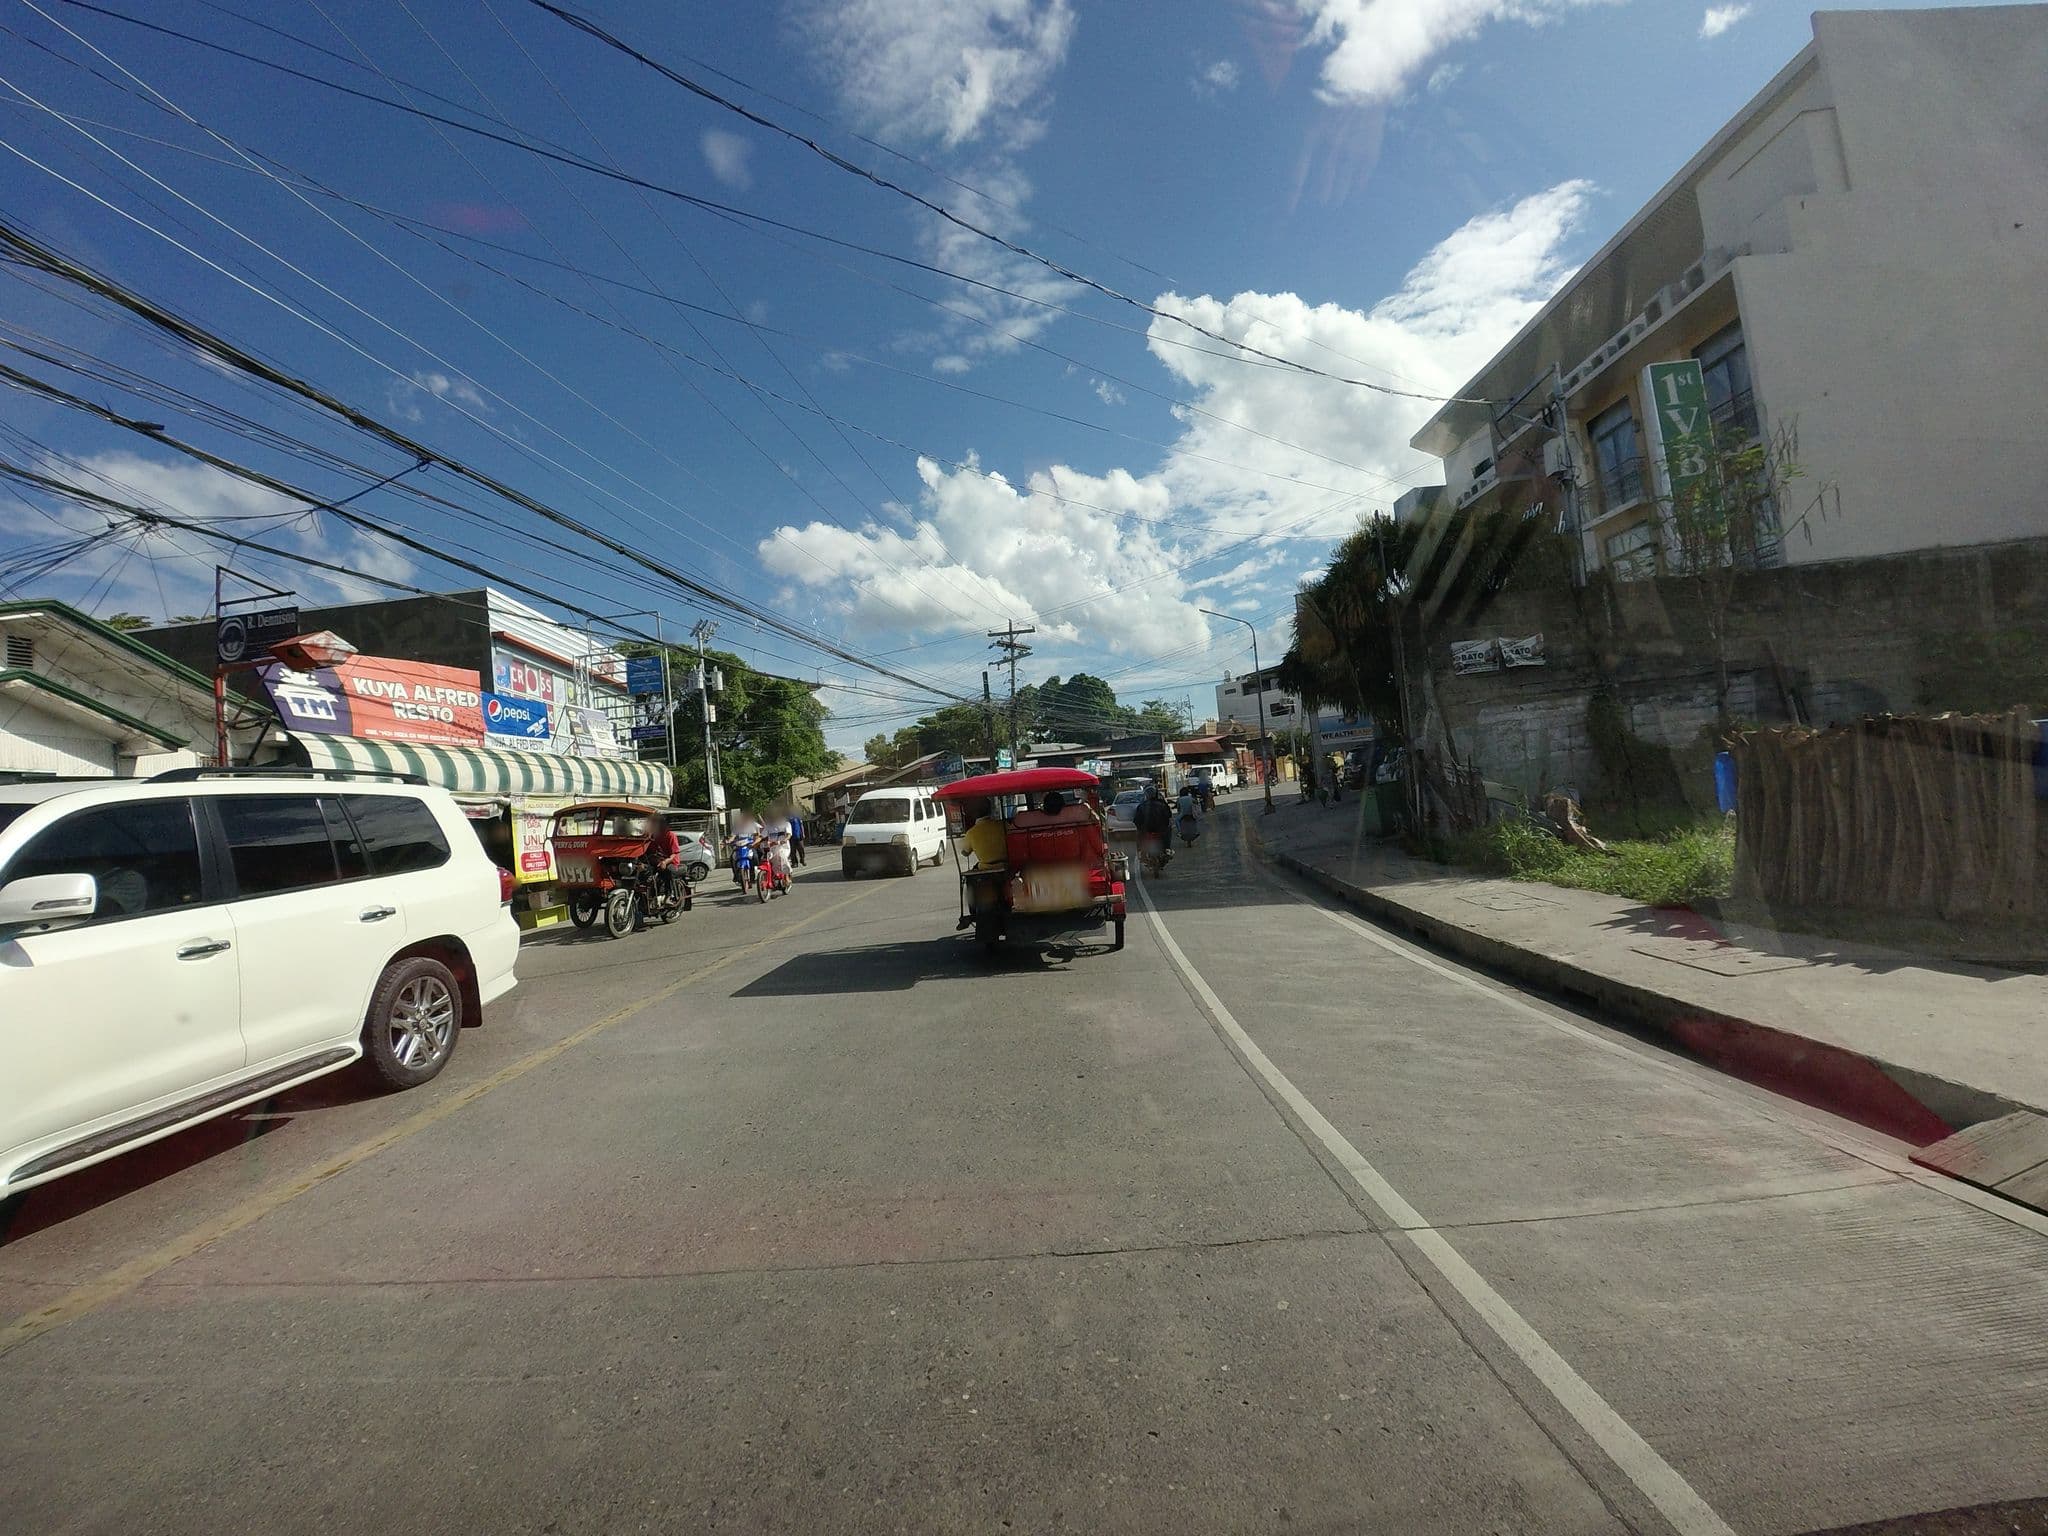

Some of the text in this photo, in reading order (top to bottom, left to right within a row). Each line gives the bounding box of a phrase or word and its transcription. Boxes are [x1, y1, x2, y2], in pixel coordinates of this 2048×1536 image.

[352, 677, 479, 708] KUYA ALFRED
[292, 698, 333, 717] TM
[392, 701, 455, 724] RESTO
[503, 707, 531, 724] pepsi
